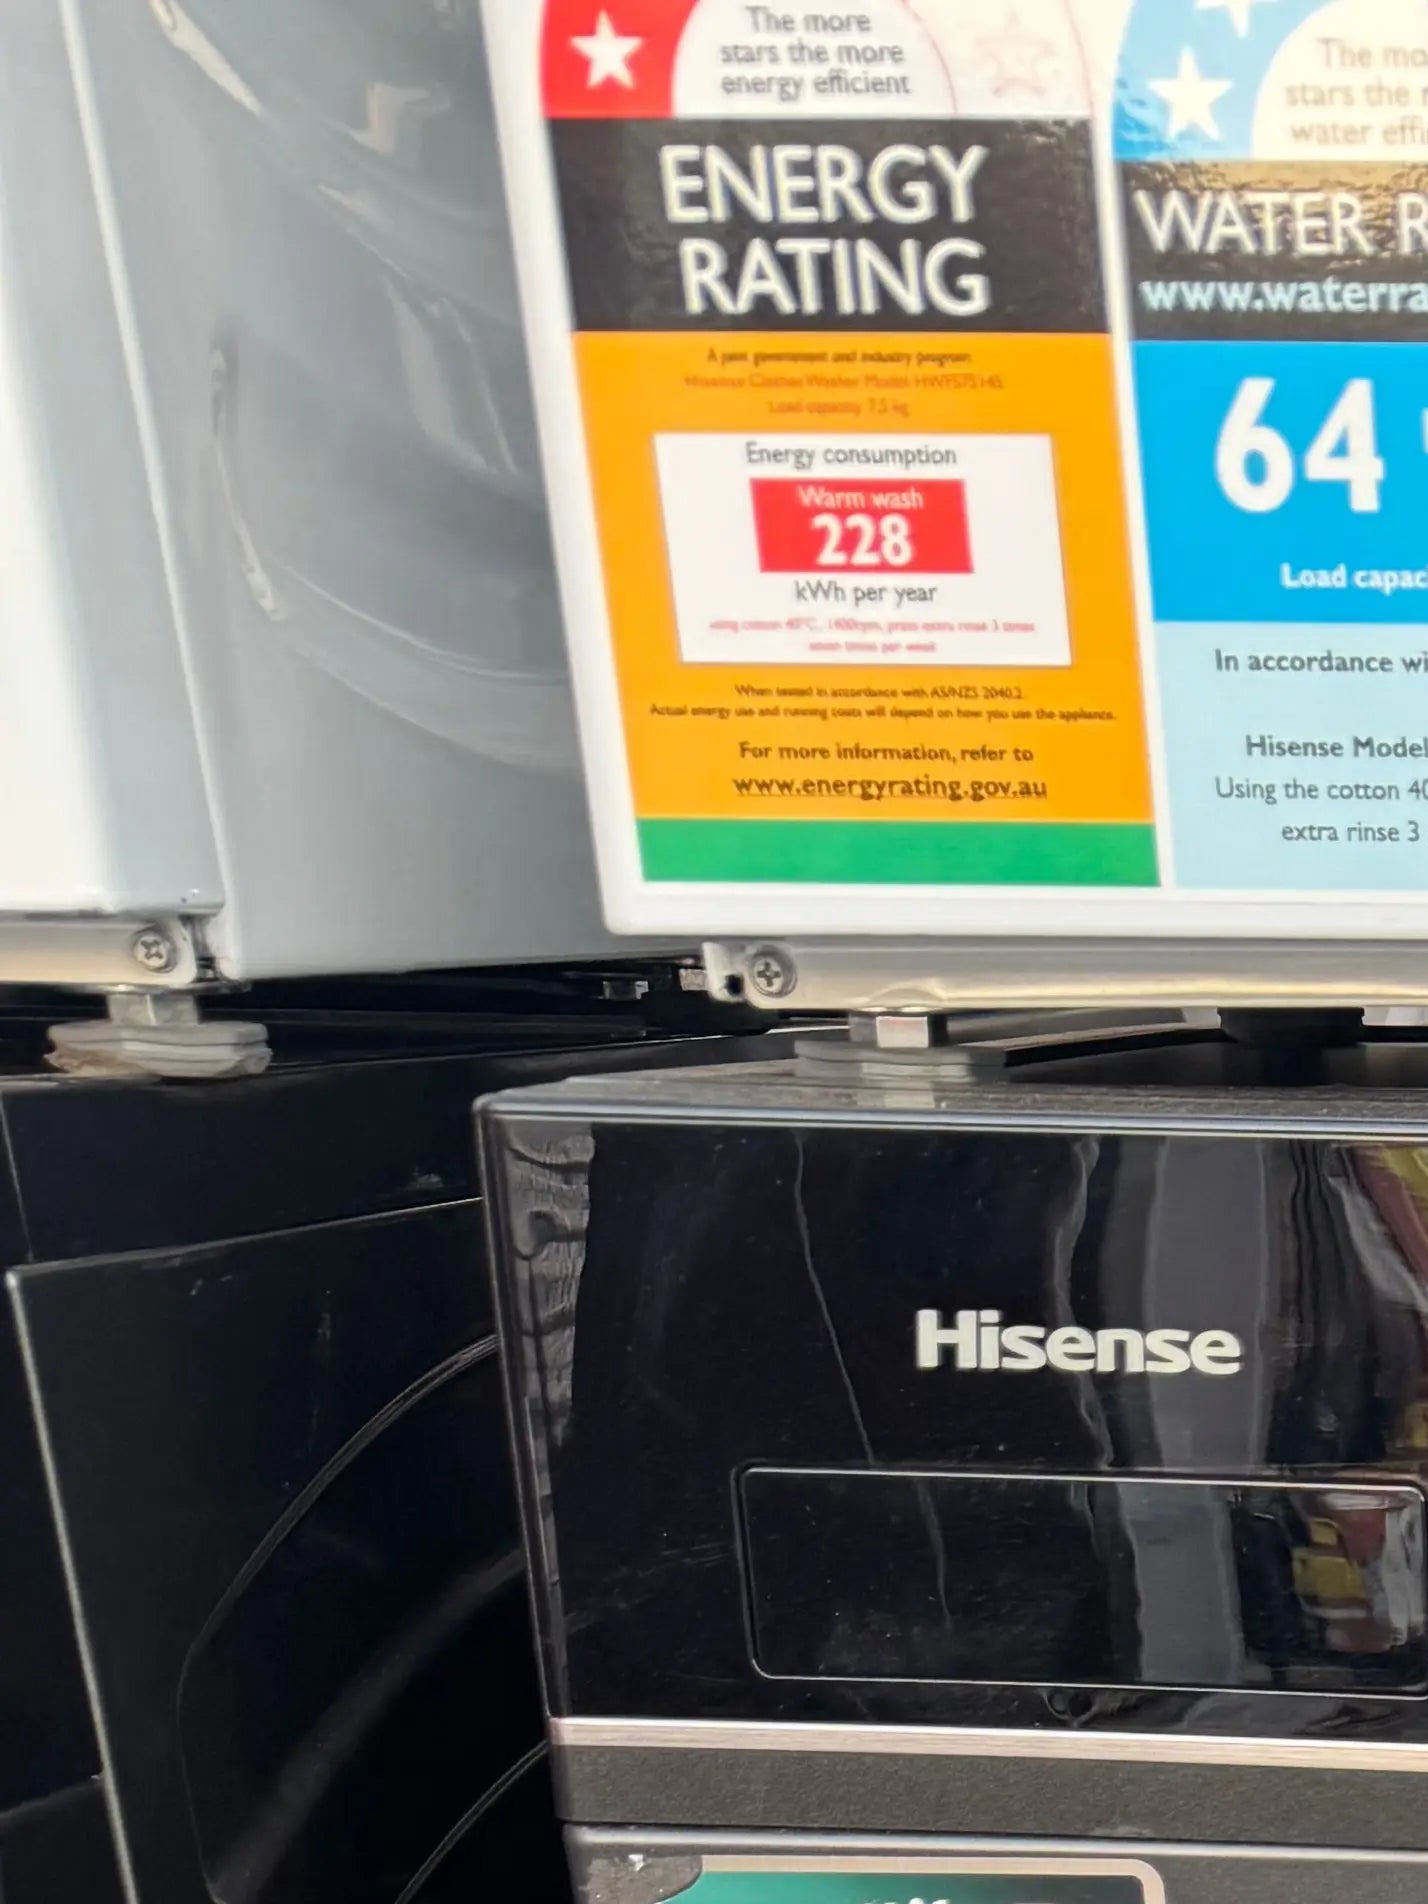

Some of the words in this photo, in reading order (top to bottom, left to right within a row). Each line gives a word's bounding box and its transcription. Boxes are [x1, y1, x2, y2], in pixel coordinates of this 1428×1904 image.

[748, 5, 795, 33] The
[804, 11, 871, 33] more
[720, 43, 780, 65] stars
[787, 40, 829, 65] the
[837, 44, 904, 65] more
[1319, 38, 1376, 69] The
[720, 74, 804, 101] energy
[813, 71, 912, 96] efficient
[1285, 84, 1354, 108] stars
[1366, 80, 1411, 108] the
[1289, 121, 1372, 146] water
[659, 142, 991, 225] ENERGY
[1133, 188, 1370, 256] WATER
[678, 237, 991, 317] RATING
[746, 441, 815, 469] Energy
[824, 444, 957, 468] consumption
[1214, 375, 1385, 515] 64
[797, 486, 866, 509] Warm
[873, 486, 924, 510] wash
[811, 512, 913, 567] 228
[1280, 562, 1348, 590] Load
[795, 580, 846, 603] kWh
[854, 584, 885, 606] per
[893, 584, 937, 605] year
[1214, 648, 1240, 673] In
[1247, 649, 1394, 674] accordance
[738, 741, 772, 760] For
[778, 744, 831, 761] more
[836, 741, 957, 764] information,
[960, 743, 1007, 762] refer
[1013, 745, 1034, 762] to
[1245, 735, 1345, 759] Hisense
[732, 774, 1048, 802] www.energyrating.gov.au
[1214, 777, 1278, 805] Using
[1284, 778, 1320, 801] the
[1326, 780, 1402, 802] cotton
[1281, 824, 1340, 844] extra
[1346, 822, 1401, 844] rinse
[1406, 820, 1421, 844] 3
[916, 1308, 1242, 1376] Hisense
